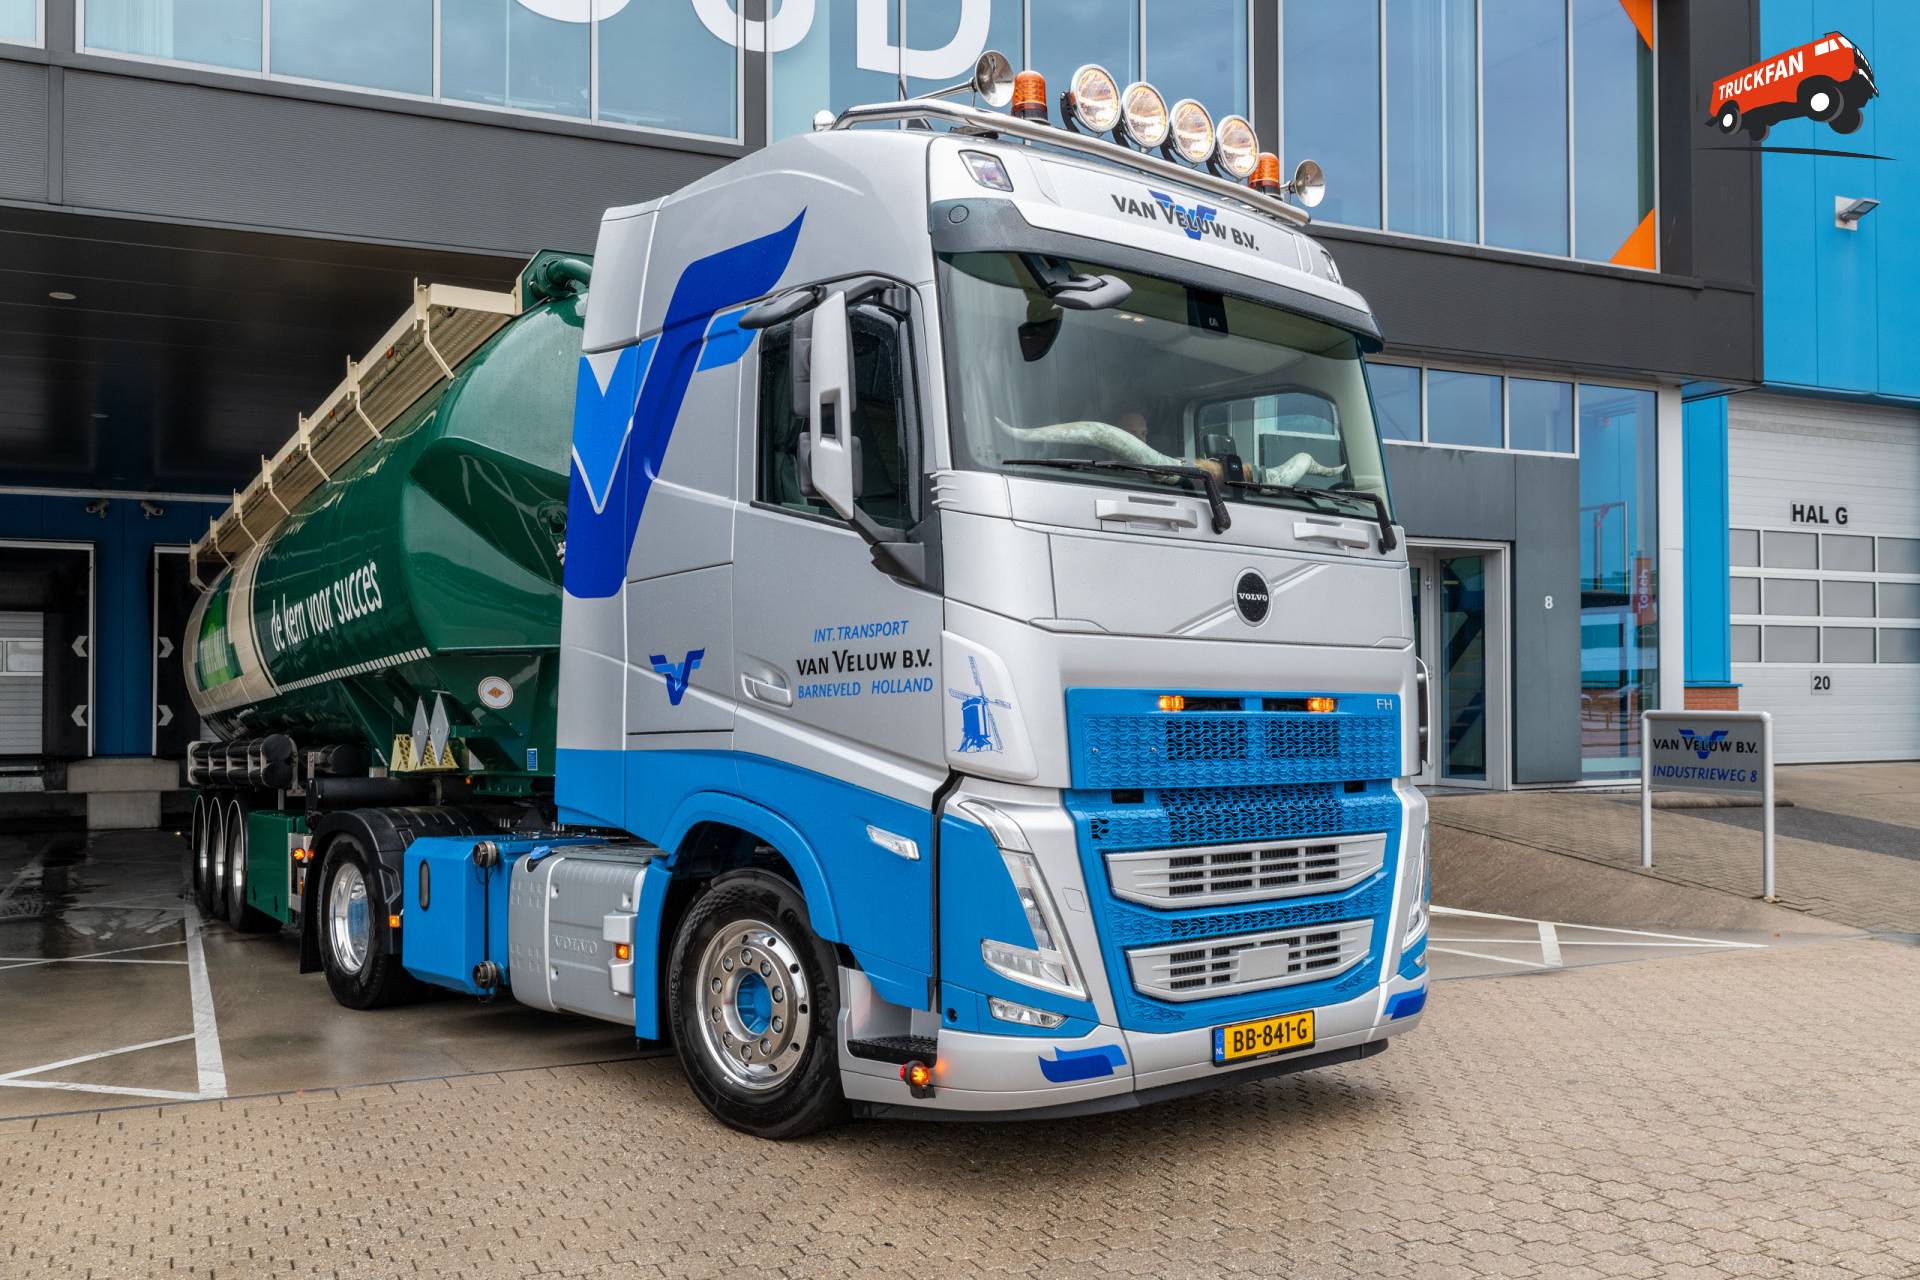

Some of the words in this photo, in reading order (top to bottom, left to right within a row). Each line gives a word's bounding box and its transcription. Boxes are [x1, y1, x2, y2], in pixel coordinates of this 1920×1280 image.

[1111, 194, 1157, 221] VAN
[1156, 199, 1227, 240] VELUW
[1230, 227, 1260, 251] B.V.
[1792, 504, 1830, 524] HAL
[1835, 506, 1848, 525] G
[271, 599, 286, 652] de
[282, 593, 309, 646] kern
[306, 587, 334, 635] voor
[334, 560, 383, 624] succes
[1238, 592, 1268, 602] VOLVO
[1544, 595, 1553, 609] 8
[837, 620, 909, 641] TRANSPORT
[796, 656, 829, 676] VAN
[832, 649, 897, 673] VELUW
[902, 649, 933, 669] B.V.
[798, 681, 862, 699] BARNEVELD
[871, 677, 934, 695] HOLLAND
[1814, 675, 1831, 691] 20
[1376, 699, 1393, 710] FH
[1653, 738, 1680, 750] VAN
[1682, 736, 1732, 752] VELUW
[1735, 741, 1758, 753] B.V.
[1652, 765, 1746, 783] INDUSTRIEWEG
[1750, 770, 1758, 783] 8
[551, 935, 598, 954] VOLVO
[1215, 1047, 1224, 1056] NL
[1233, 1018, 1308, 1053] BB-841-G
